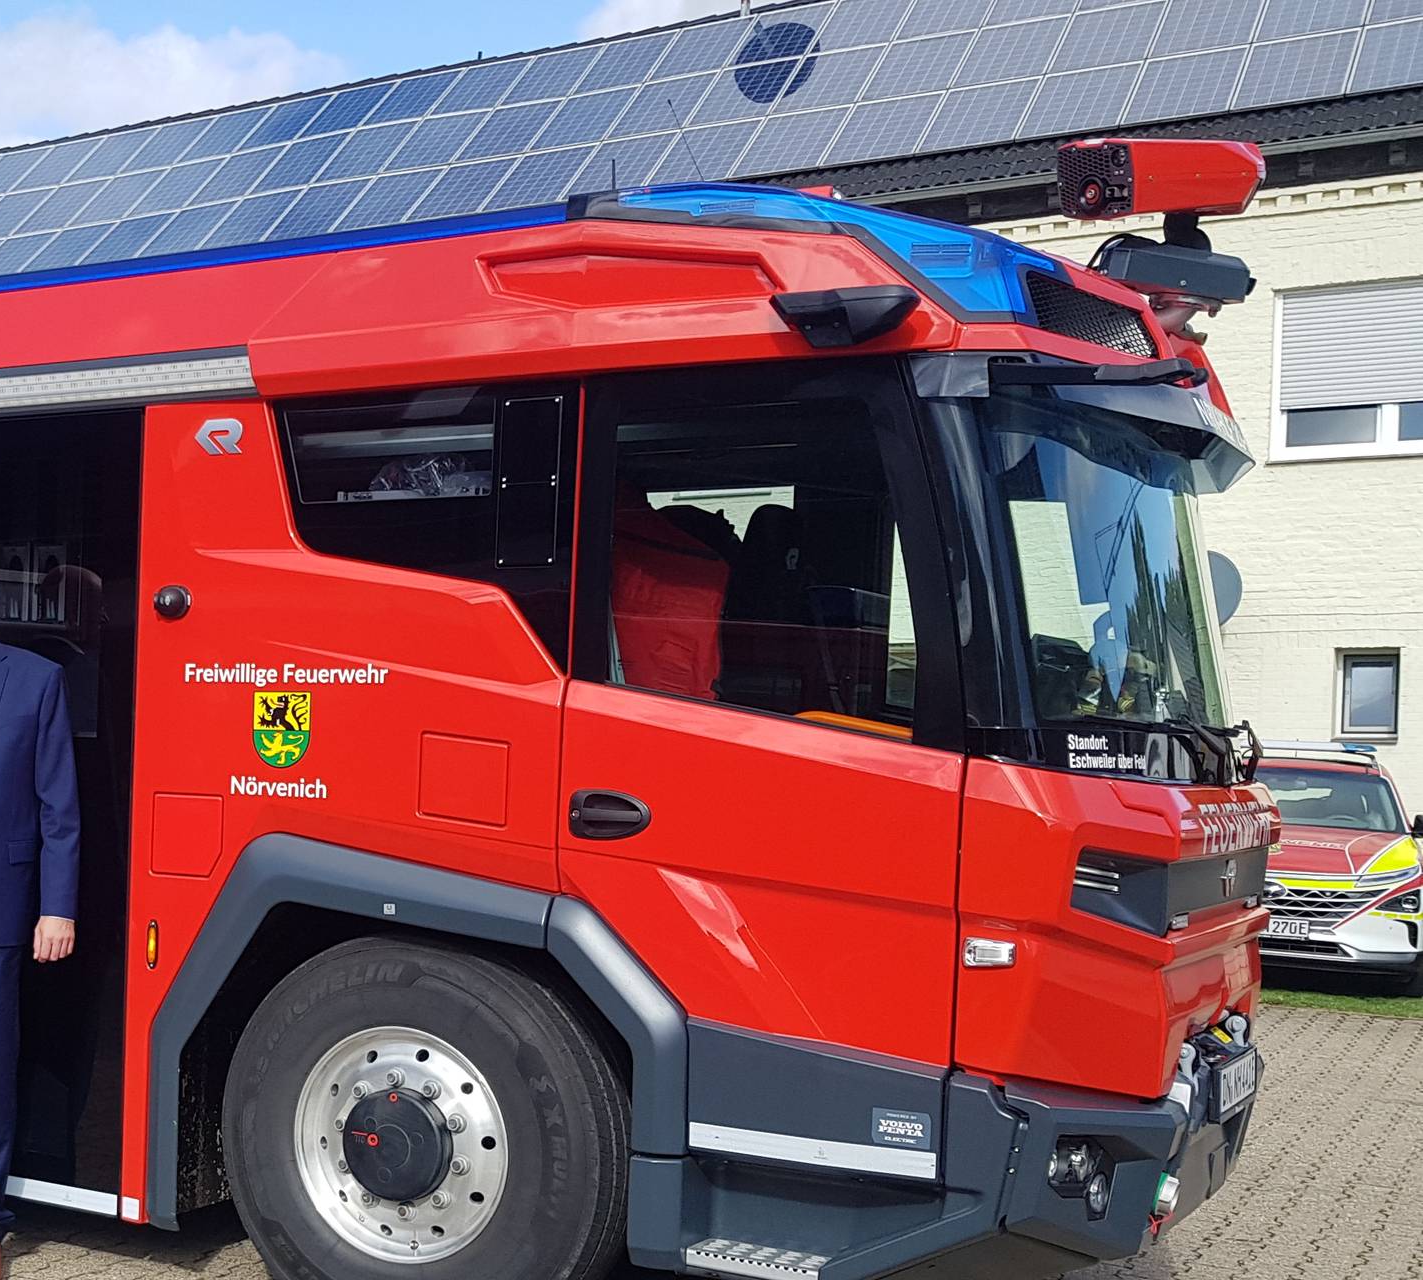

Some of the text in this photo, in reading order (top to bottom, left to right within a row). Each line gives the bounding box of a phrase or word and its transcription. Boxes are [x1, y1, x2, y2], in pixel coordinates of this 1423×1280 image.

[184, 663, 389, 687] Freiwillige Feuerwehr
[1067, 733, 1109, 750] Standort:
[1069, 752, 1116, 769] Eschweiler
[1118, 753, 1134, 769] über
[230, 776, 328, 800] Nörvenich
[1272, 920, 1307, 935] 270E
[877, 1125, 924, 1138] PENTA
[878, 1118, 923, 1131] VOLVO
